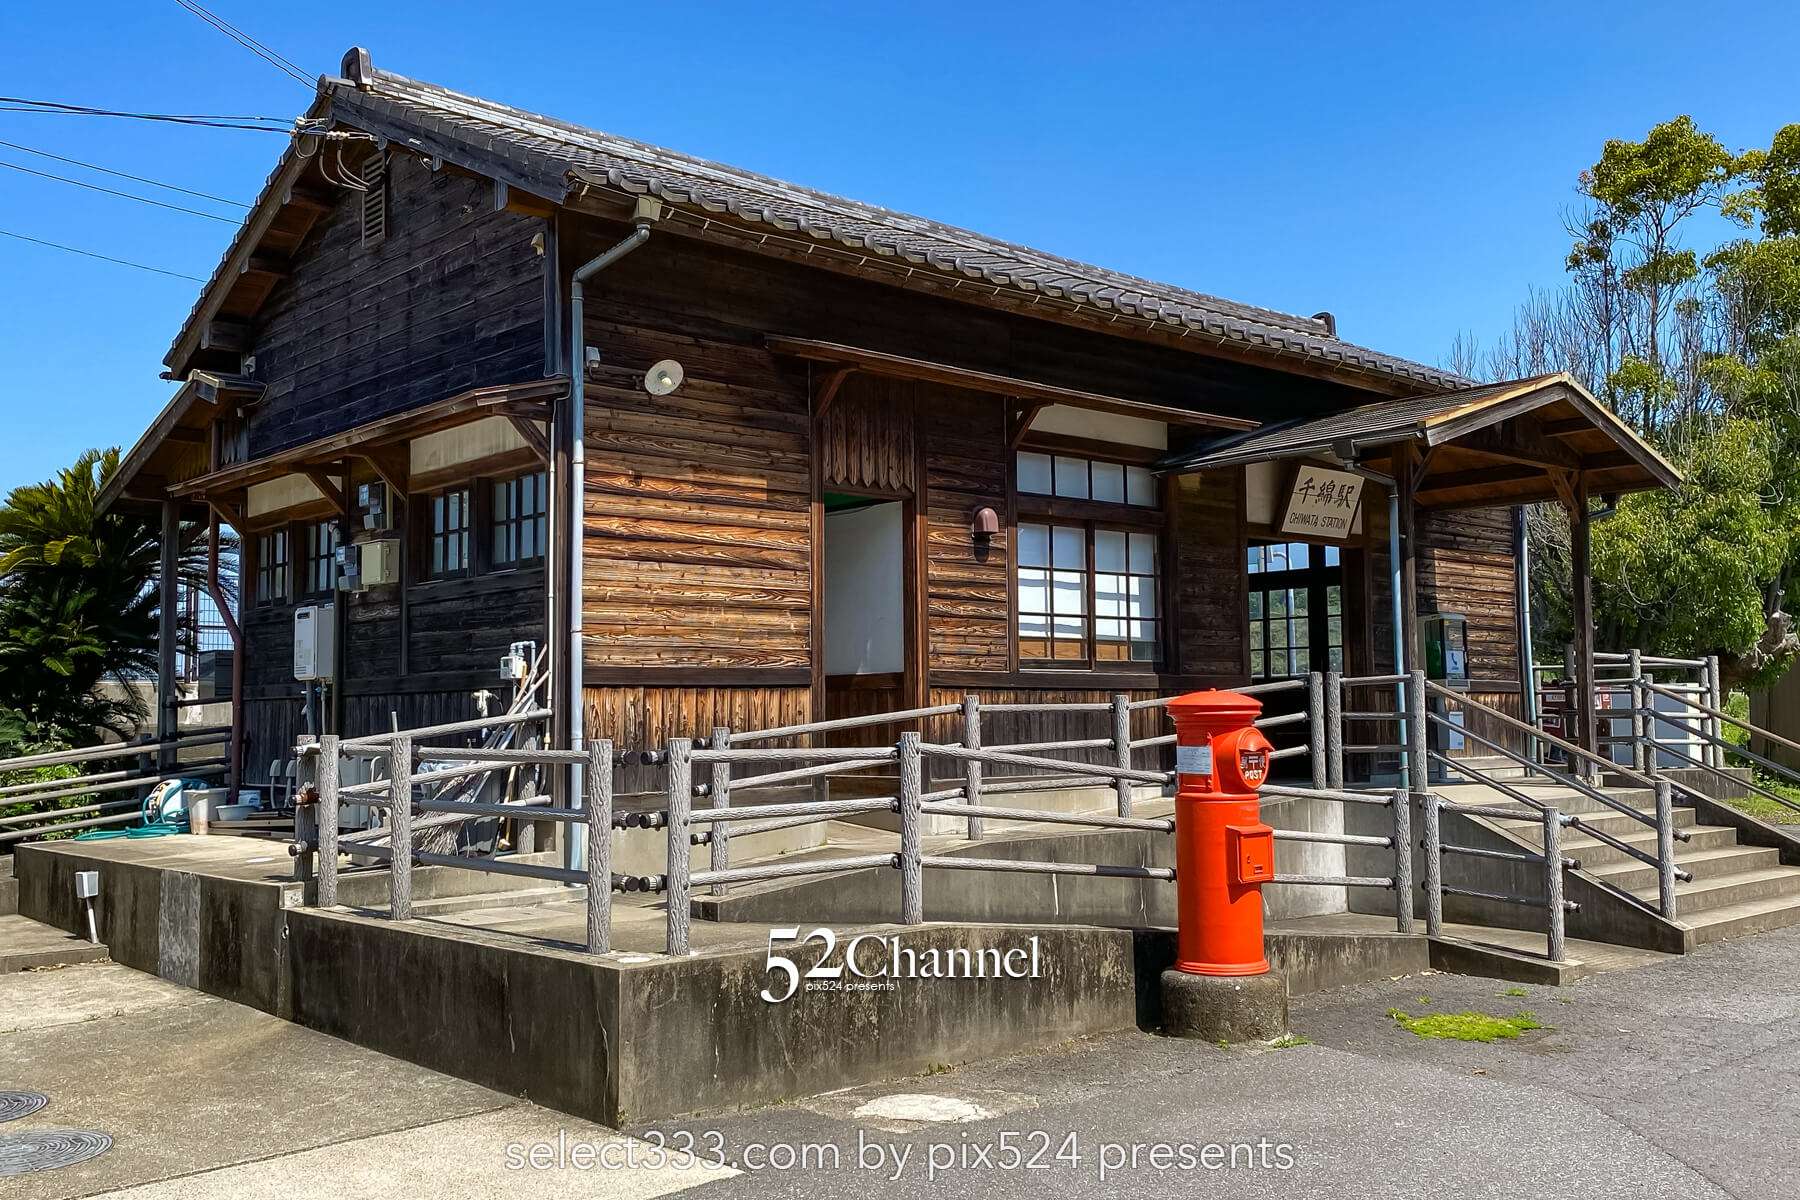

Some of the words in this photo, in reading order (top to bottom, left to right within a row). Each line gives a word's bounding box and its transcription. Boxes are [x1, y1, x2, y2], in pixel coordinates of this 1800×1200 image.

[1298, 476, 1355, 509] 千綿駅
[1289, 512, 1319, 528] CHIWATA
[1320, 516, 1348, 530] STATION
[1244, 770, 1263, 780] POST
